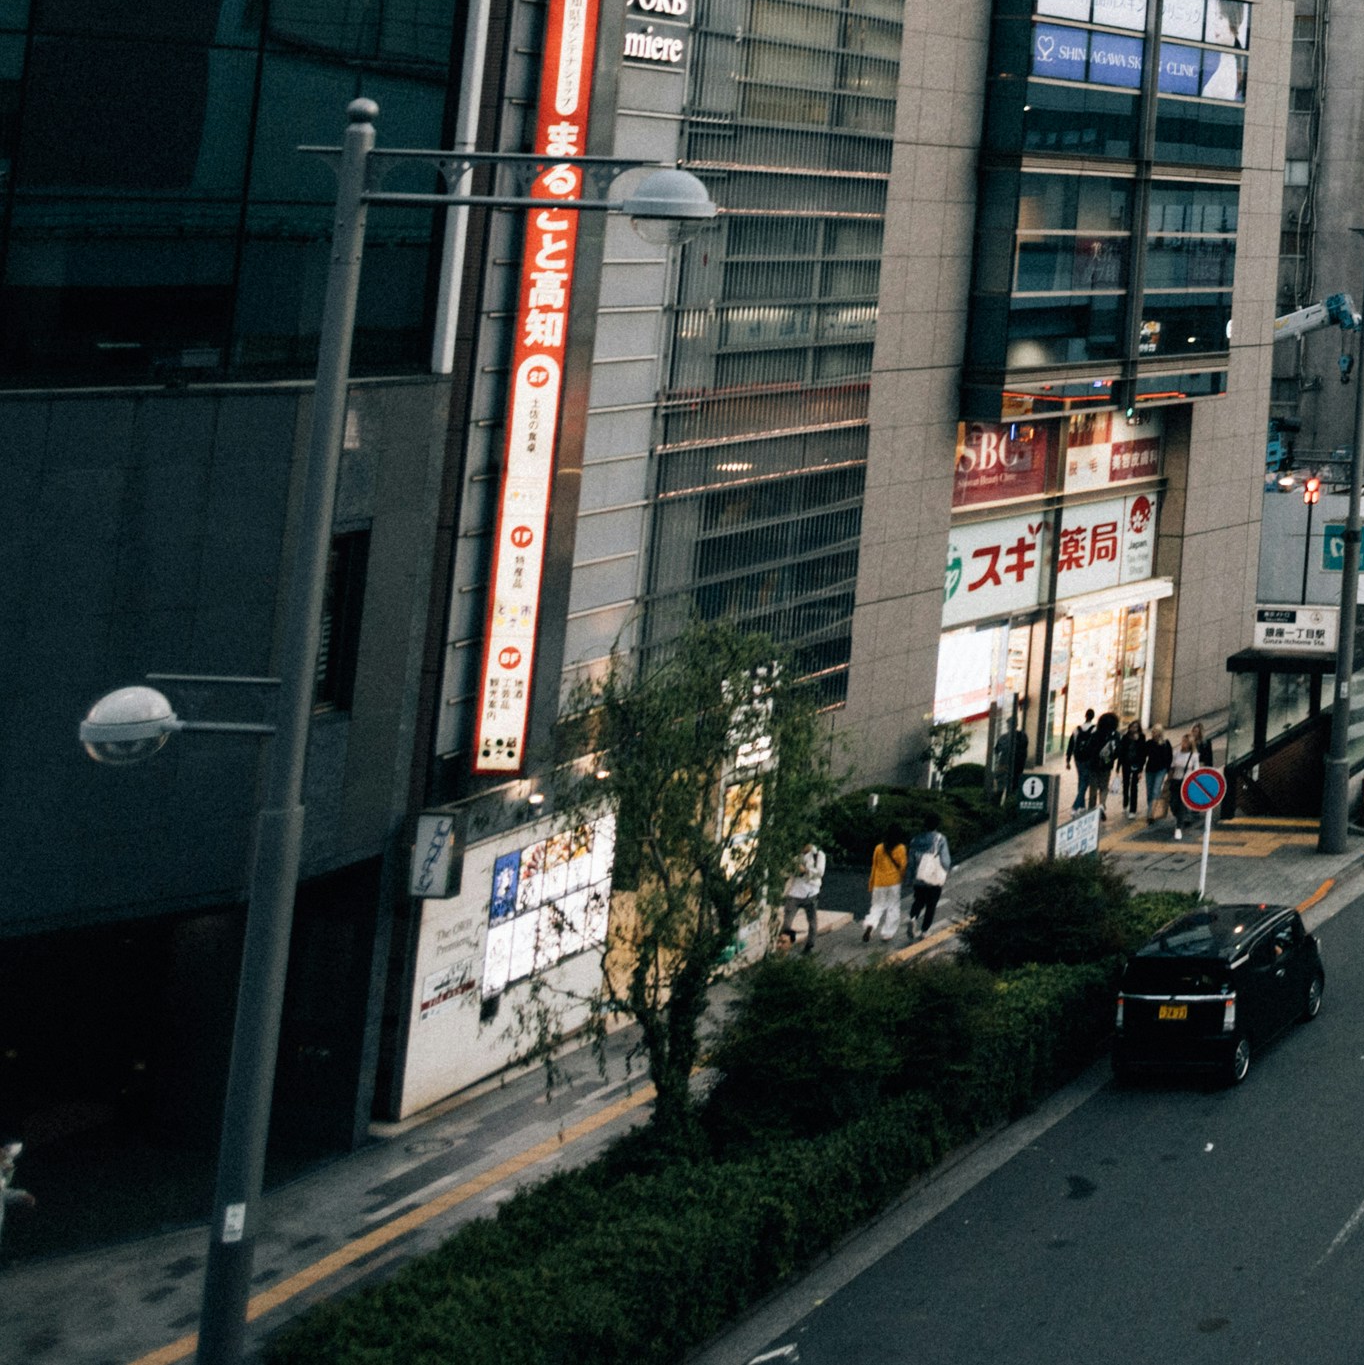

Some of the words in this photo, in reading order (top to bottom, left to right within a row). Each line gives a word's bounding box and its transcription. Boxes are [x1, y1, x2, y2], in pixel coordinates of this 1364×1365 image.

[623, 26, 683, 63] miere
[1058, 44, 1127, 67] SHINAGAWA
[1166, 61, 1199, 78] CLINIC
[528, 371, 547, 383] 2F
[967, 522, 1118, 593] スギ薬局
[1265, 627, 1326, 639] 銀座一丁目駅
